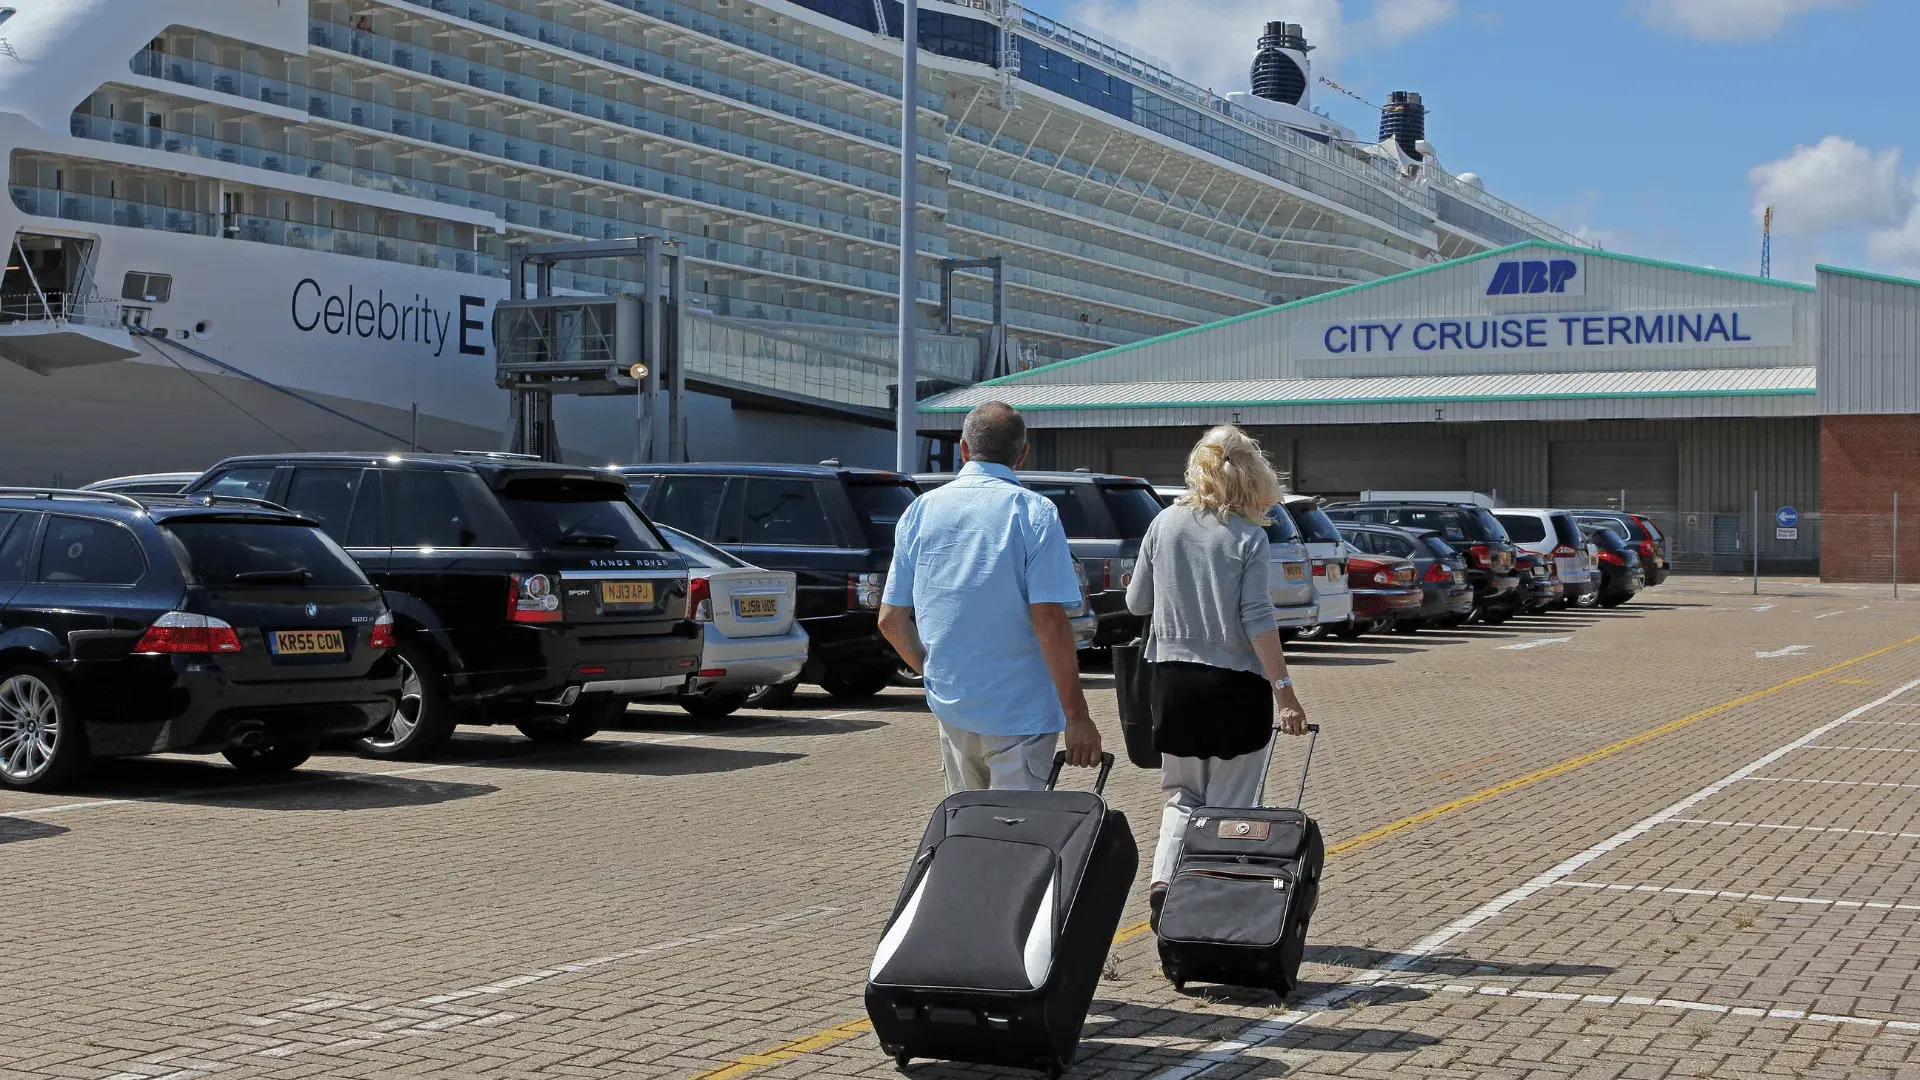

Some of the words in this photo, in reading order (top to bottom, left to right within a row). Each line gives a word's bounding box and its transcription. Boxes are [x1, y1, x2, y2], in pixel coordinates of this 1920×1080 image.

[1486, 259, 1577, 296] ABP
[291, 277, 451, 358] Celebrity
[459, 294, 497, 357] E
[1324, 323, 1403, 354] CITY
[1412, 318, 1548, 351] CRUISE
[1558, 312, 1752, 347] TERMINAL
[590, 559, 631, 567] RANGE
[608, 584, 630, 599] NJ13
[278, 633, 315, 651] KR55
